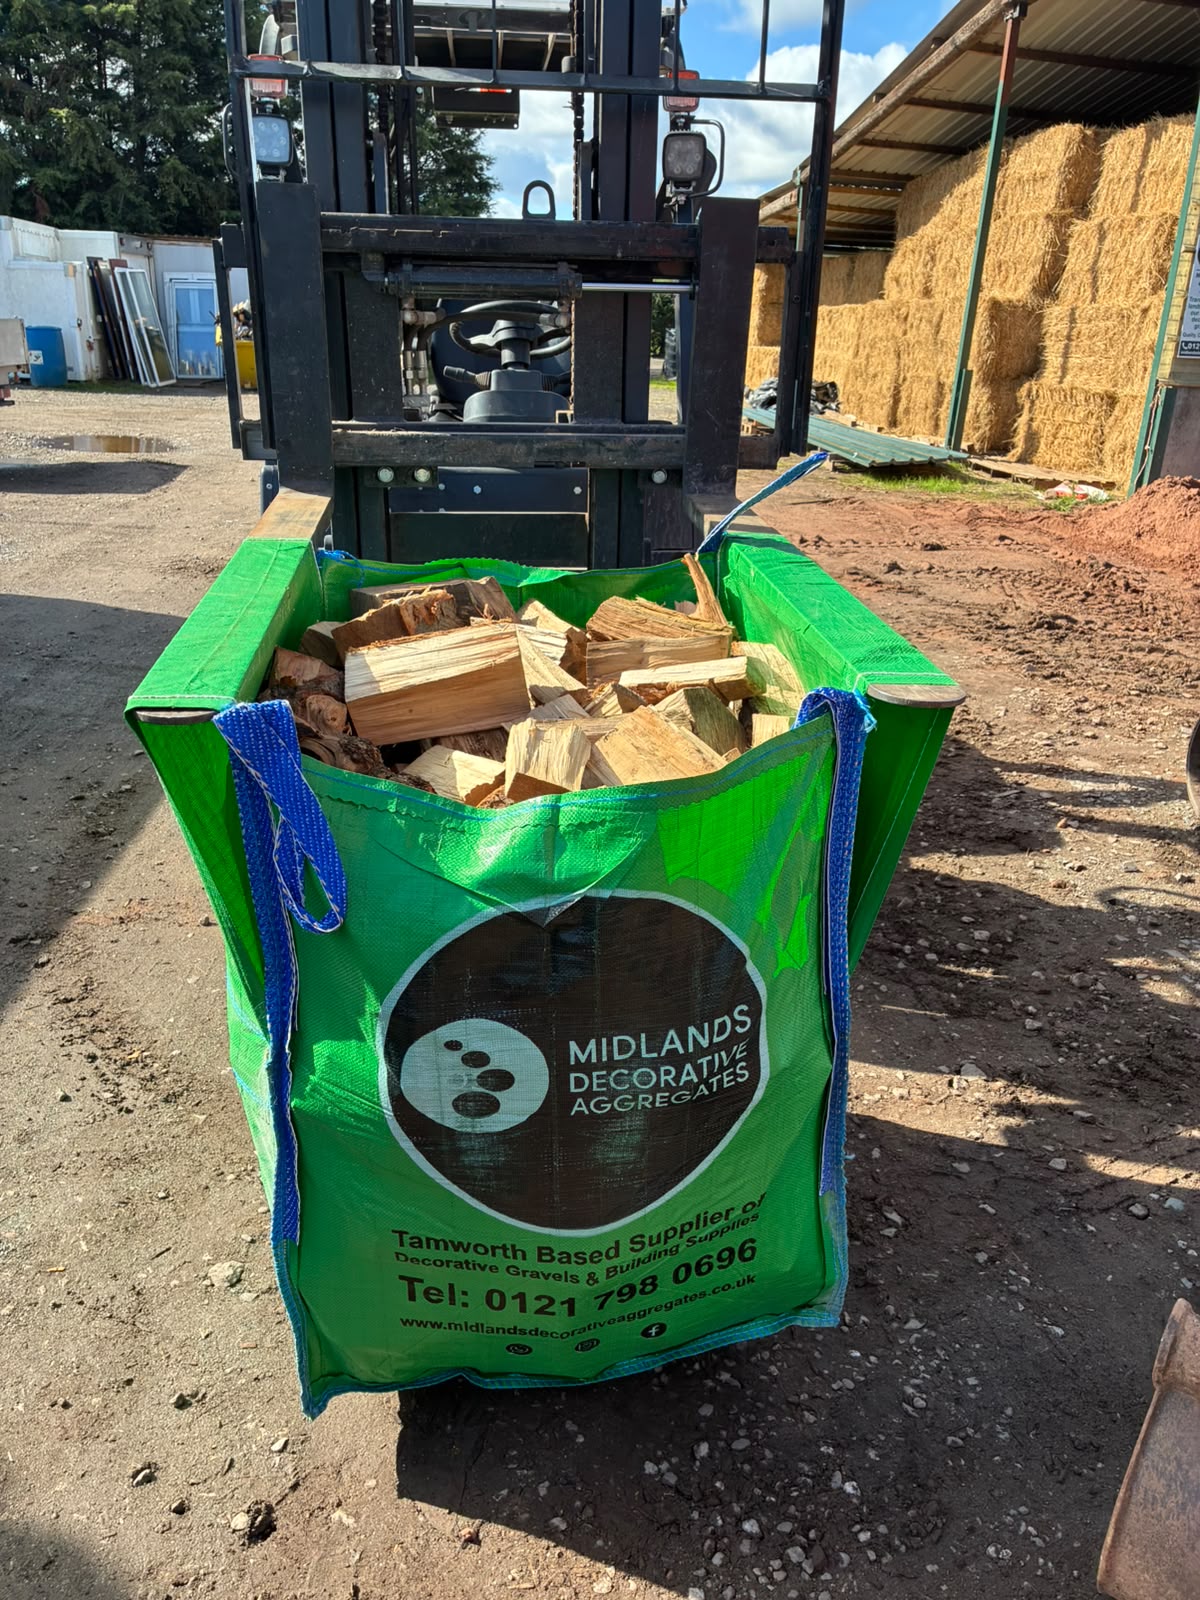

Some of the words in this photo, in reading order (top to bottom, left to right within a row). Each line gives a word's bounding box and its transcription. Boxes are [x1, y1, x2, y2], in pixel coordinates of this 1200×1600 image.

[569, 1004, 751, 1065] MIDLANDS
[569, 1038, 749, 1093] DECORATIVE
[570, 1061, 749, 1116] AGGREGATES
[391, 1229, 527, 1261] Tamworth
[536, 1240, 620, 1266] Based
[629, 1206, 735, 1253] Supplier
[394, 1251, 499, 1274] Decorative
[505, 1265, 580, 1284] Gravels
[586, 1271, 599, 1286] &
[605, 1243, 680, 1280] Building
[686, 1213, 760, 1248] Supplies
[398, 1274, 469, 1309] Tel:
[484, 1288, 576, 1317] 0121
[594, 1274, 659, 1311] 798
[672, 1237, 757, 1285] 0696
[400, 1274, 756, 1340] www.midlandsdecorativeaggregates.co.uk
